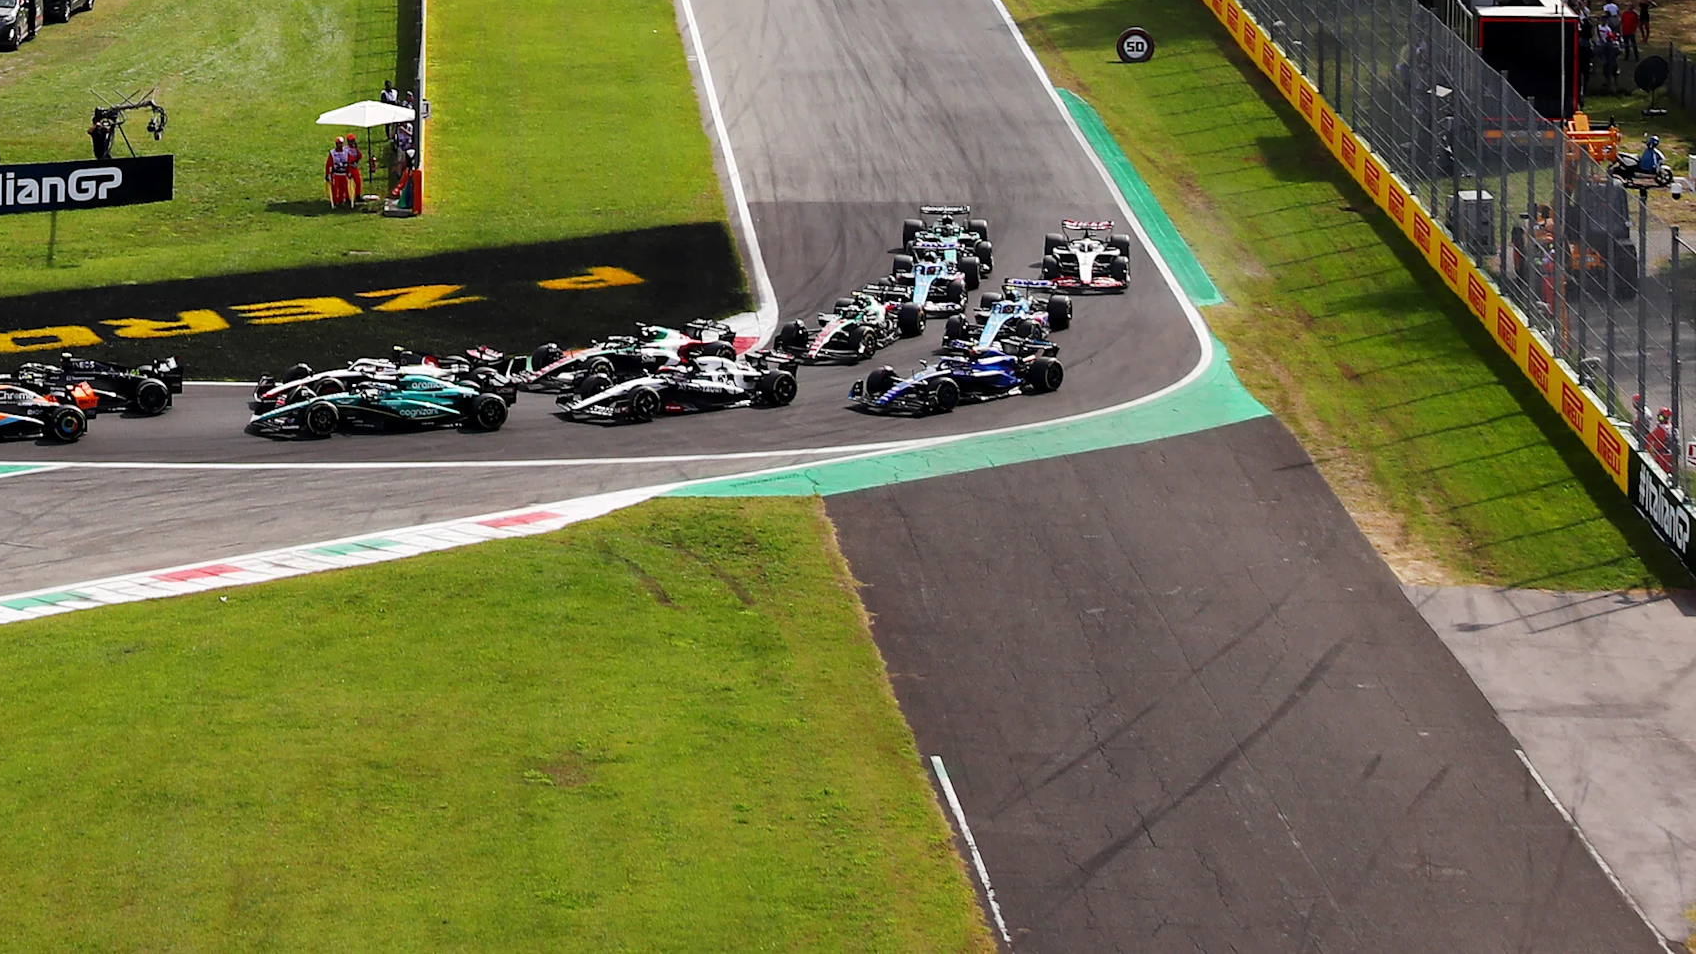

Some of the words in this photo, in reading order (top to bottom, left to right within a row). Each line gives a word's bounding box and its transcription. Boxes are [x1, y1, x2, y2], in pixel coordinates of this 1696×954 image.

[1126, 41, 1145, 52] 50
[1413, 211, 1431, 254] PIRELLI
[1439, 240, 1458, 286] PIRELLI
[1468, 271, 1486, 320] PIRELLI
[1497, 306, 1517, 355] PIRELLI
[1528, 342, 1548, 394] PIRELLI
[1562, 381, 1584, 434] PIRELLI
[1597, 420, 1621, 476] PIRELLI
[1638, 462, 1691, 554] #ItalianGP
